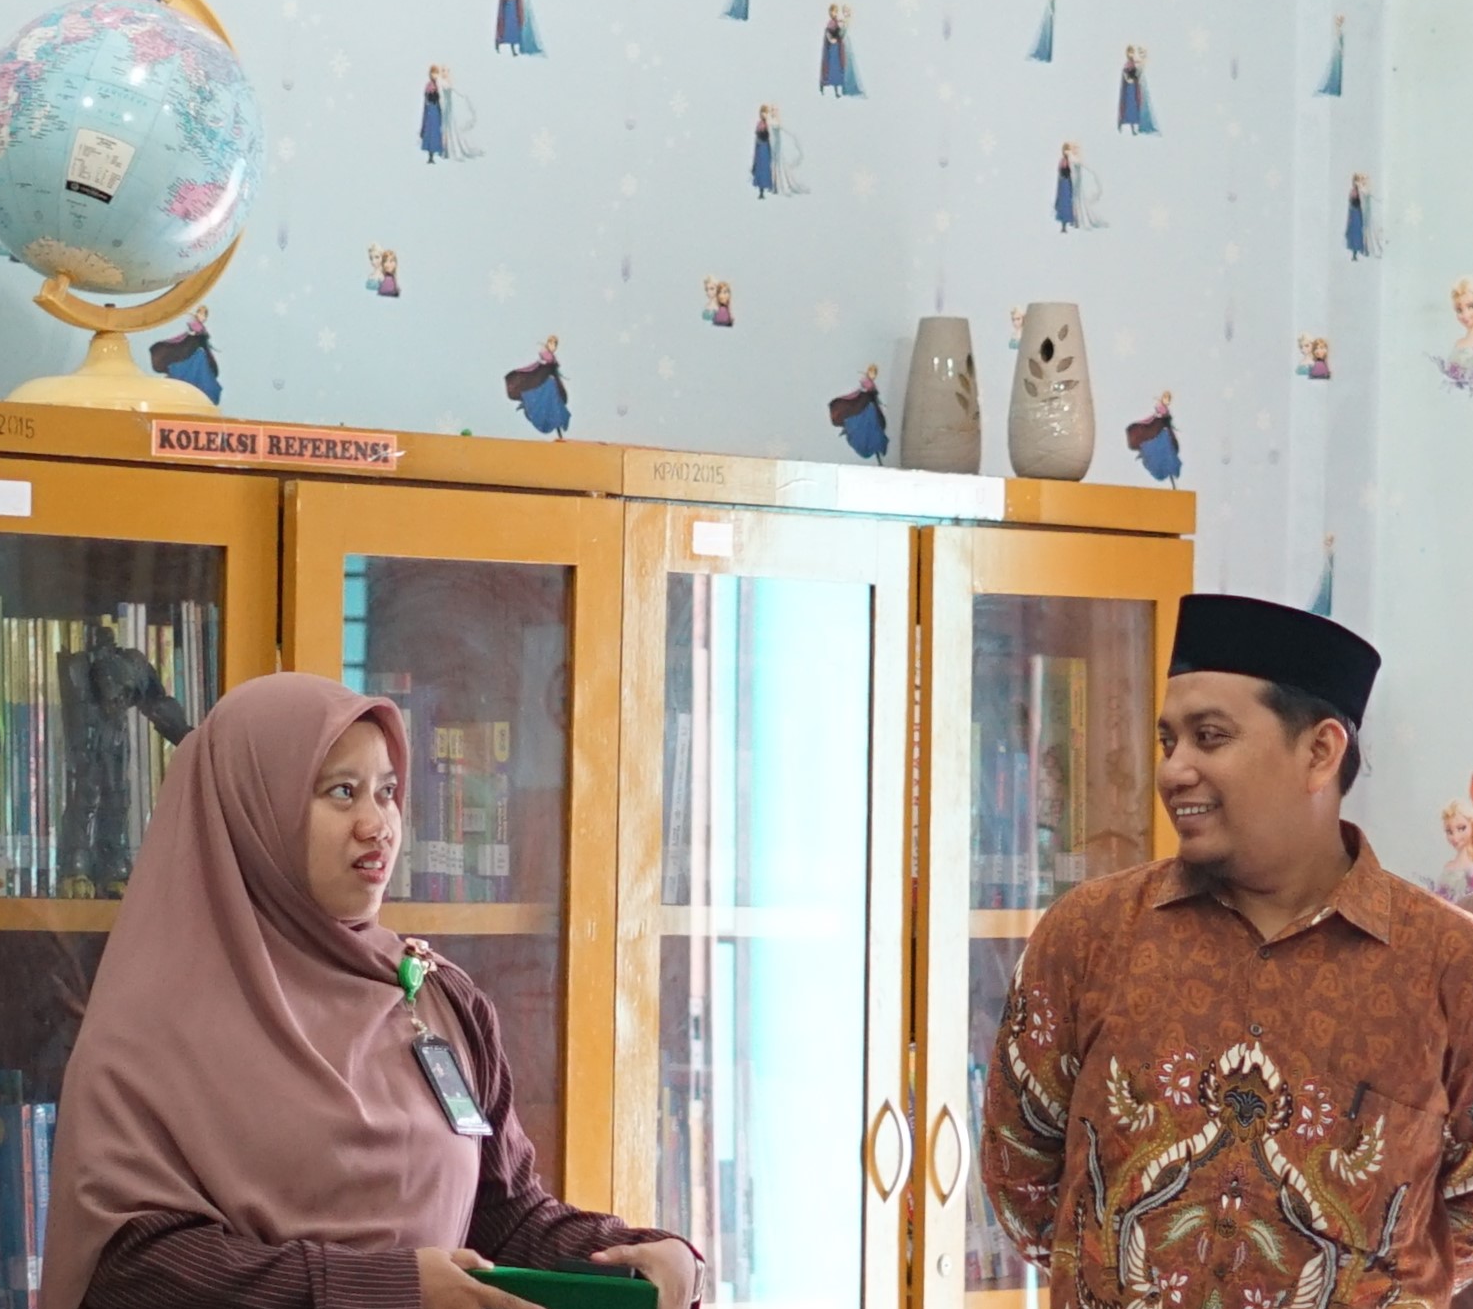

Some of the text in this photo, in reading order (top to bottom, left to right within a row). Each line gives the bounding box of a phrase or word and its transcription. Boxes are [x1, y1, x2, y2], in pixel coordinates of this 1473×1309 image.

[159, 428, 390, 463] KOLEKSI REFERENSI
[653, 461, 725, 485] KPAD 2015
